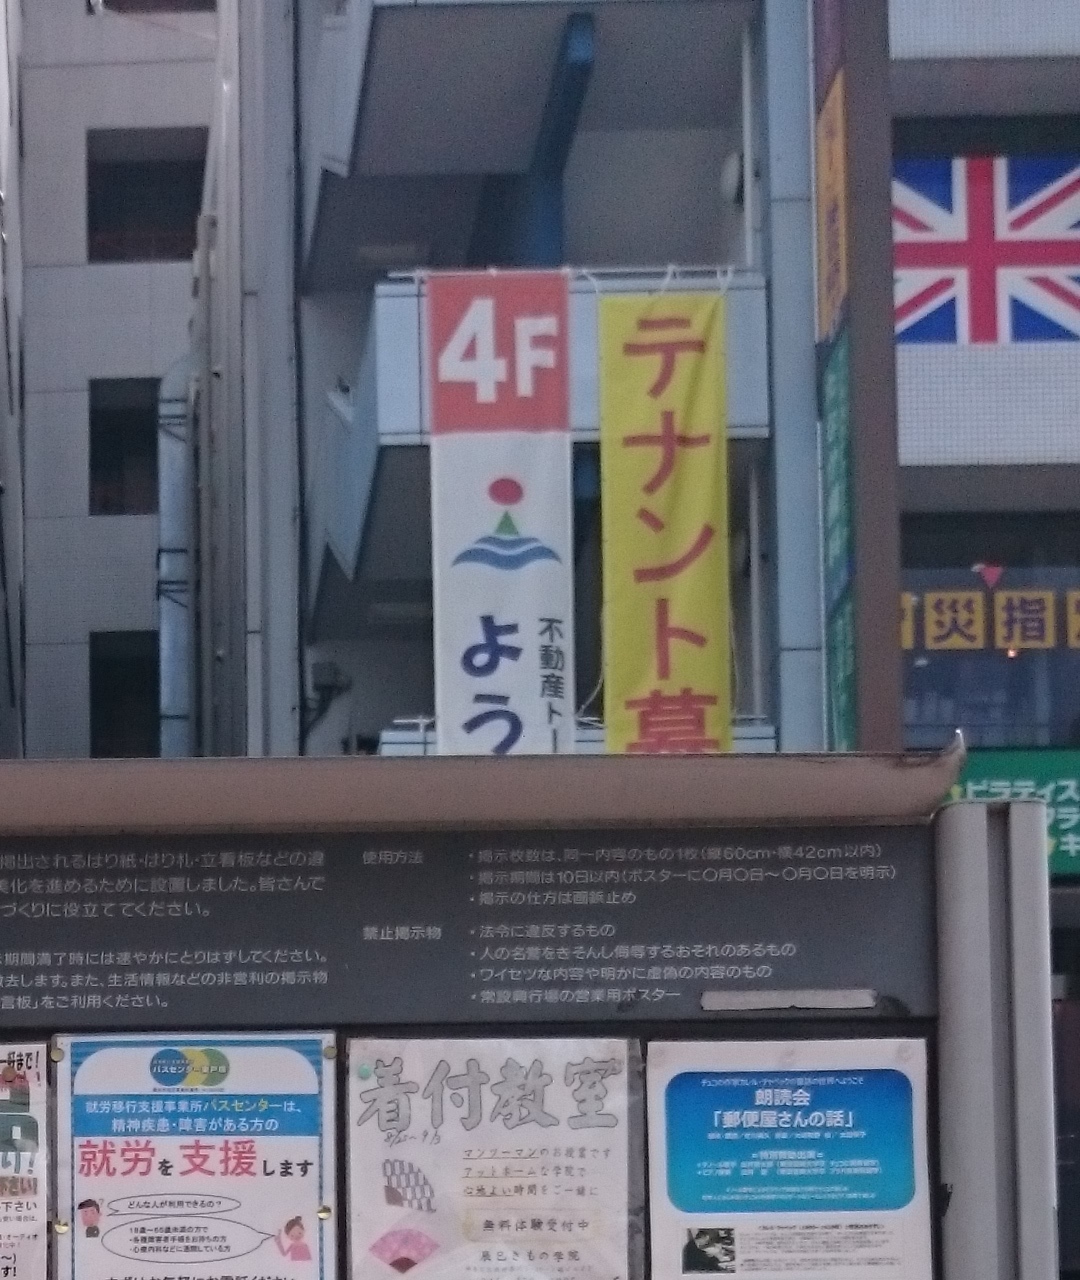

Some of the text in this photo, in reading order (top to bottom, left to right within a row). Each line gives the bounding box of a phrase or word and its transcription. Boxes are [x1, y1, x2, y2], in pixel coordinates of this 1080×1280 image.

[438, 299, 558, 402] 4F
[357, 1056, 623, 1131] 着付教室
[754, 1088, 810, 1107] 朗読会
[712, 1109, 855, 1129] 「郵便屋さんの話」
[78, 1138, 314, 1178] 就労を支援します
[482, 1219, 590, 1232] 無料体験受付中
